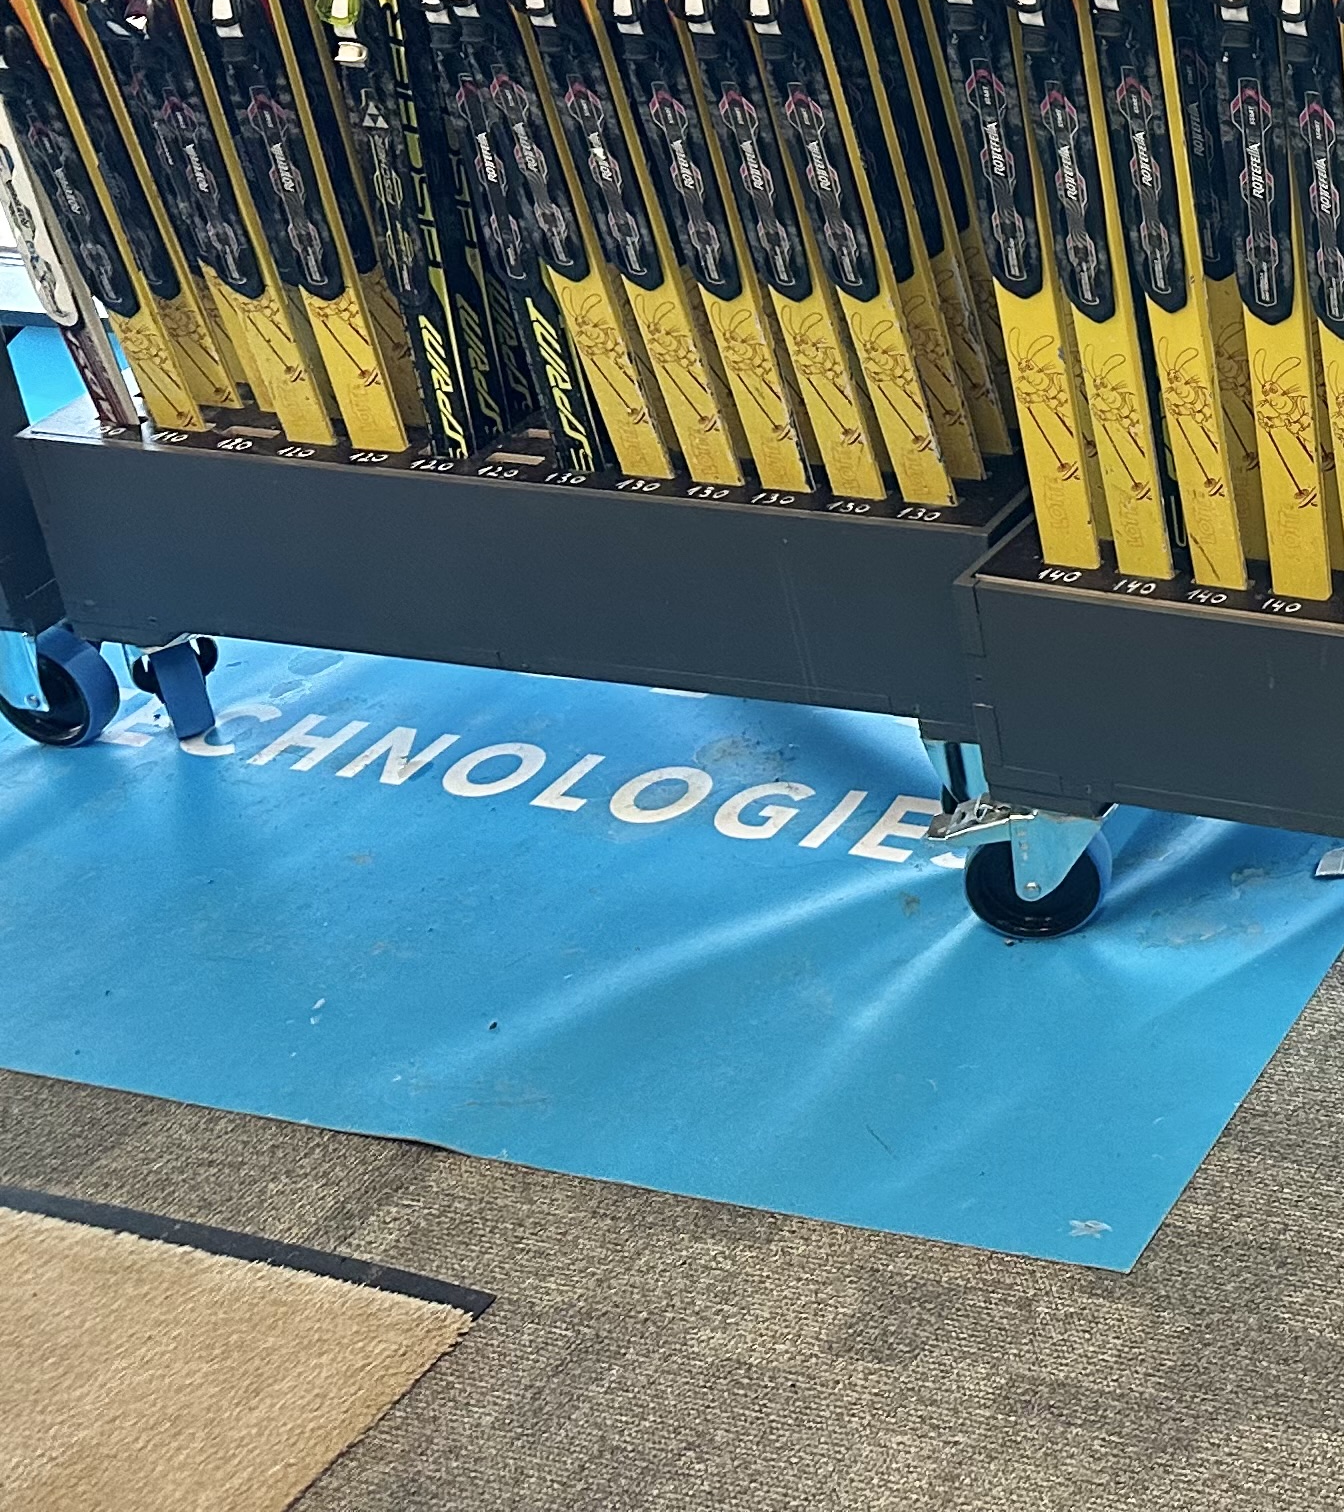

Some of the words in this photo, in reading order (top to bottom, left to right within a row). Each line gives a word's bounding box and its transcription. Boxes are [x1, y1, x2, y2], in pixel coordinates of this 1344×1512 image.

[410, 458, 454, 472] 120
[477, 465, 520, 479] 120
[545, 471, 587, 486] 130
[752, 491, 795, 506] 130
[896, 506, 942, 523] 130
[1038, 566, 1082, 585] 140
[1114, 578, 1157, 596] 140
[1187, 588, 1227, 605] 140
[1261, 597, 1302, 615] 140
